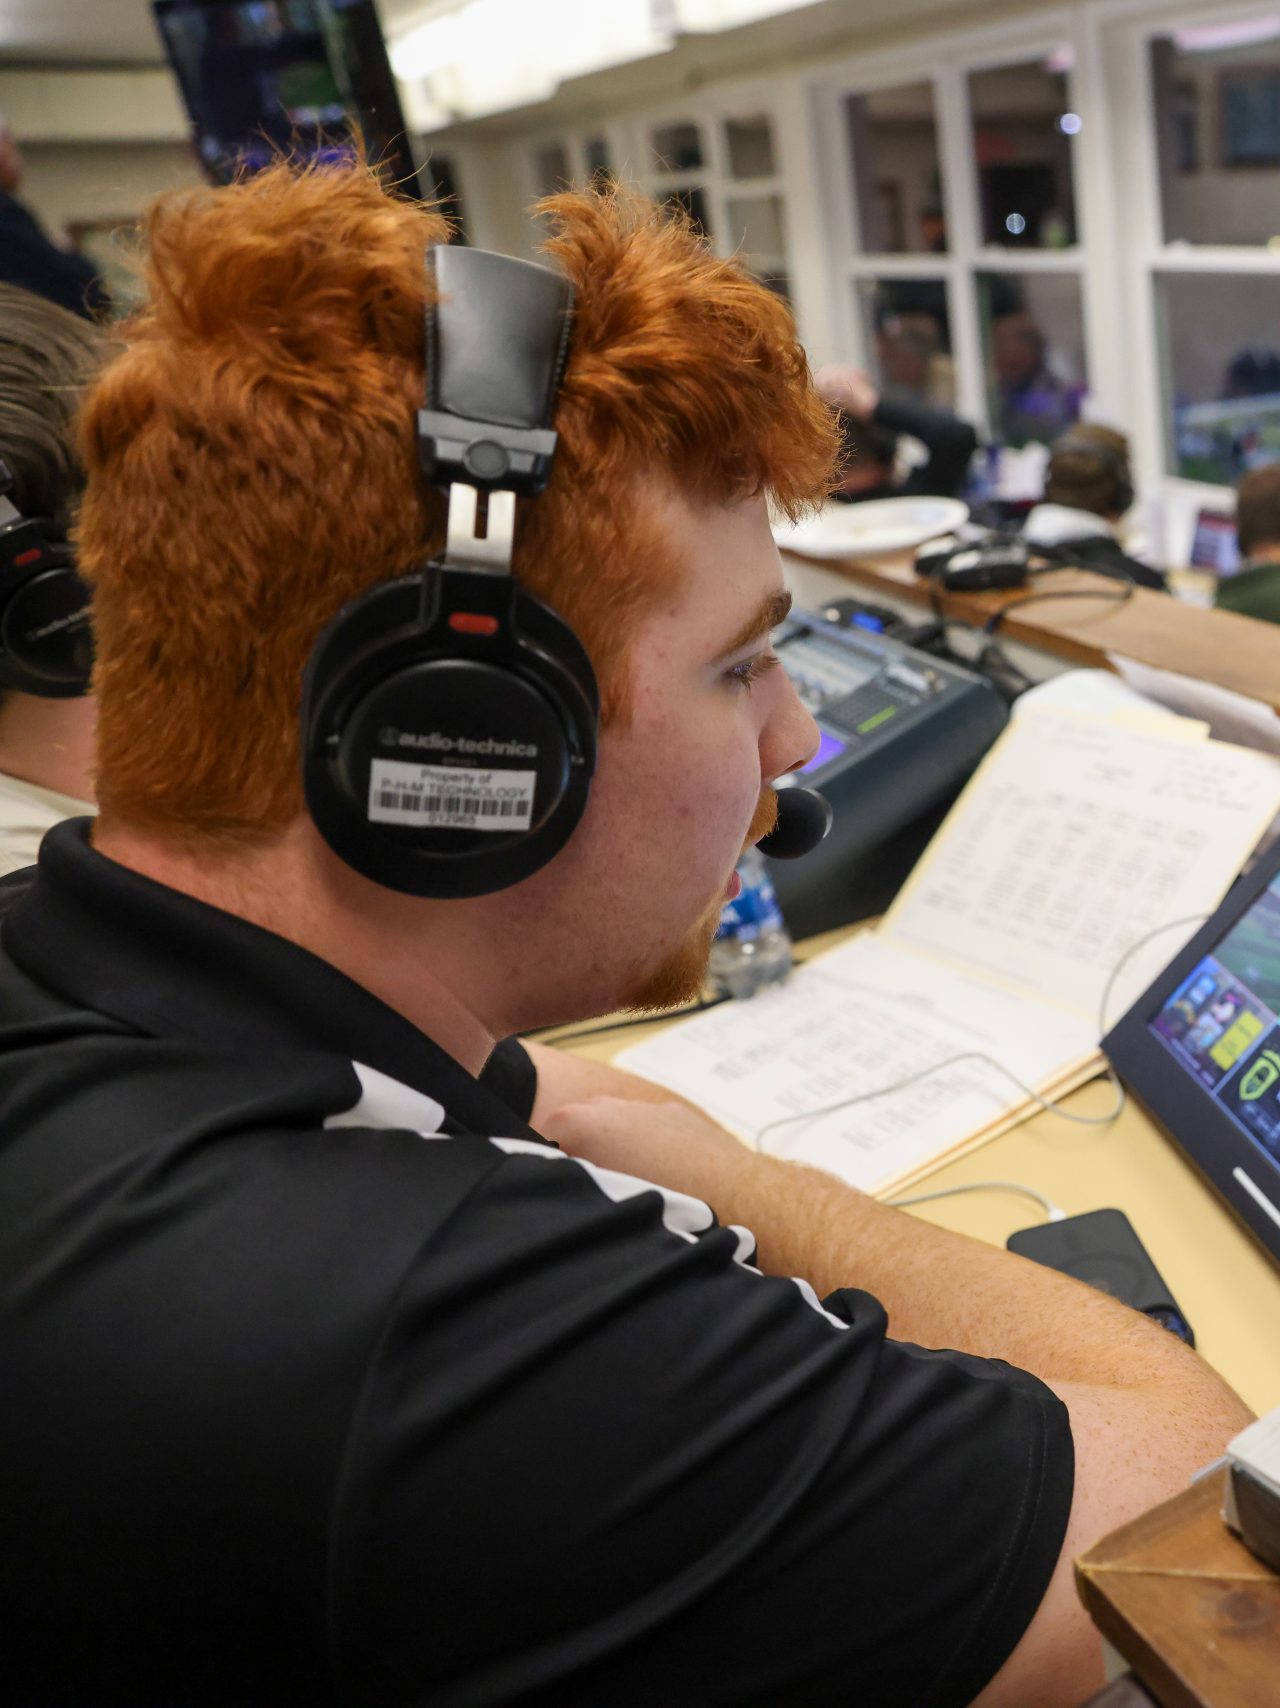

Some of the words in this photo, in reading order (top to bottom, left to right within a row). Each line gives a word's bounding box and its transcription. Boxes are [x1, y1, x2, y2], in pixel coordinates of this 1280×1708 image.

[399, 731, 538, 758] audio-technica
[420, 768, 478, 785] Property
[479, 772, 493, 785] of
[429, 782, 528, 799] TECHNOLOGY
